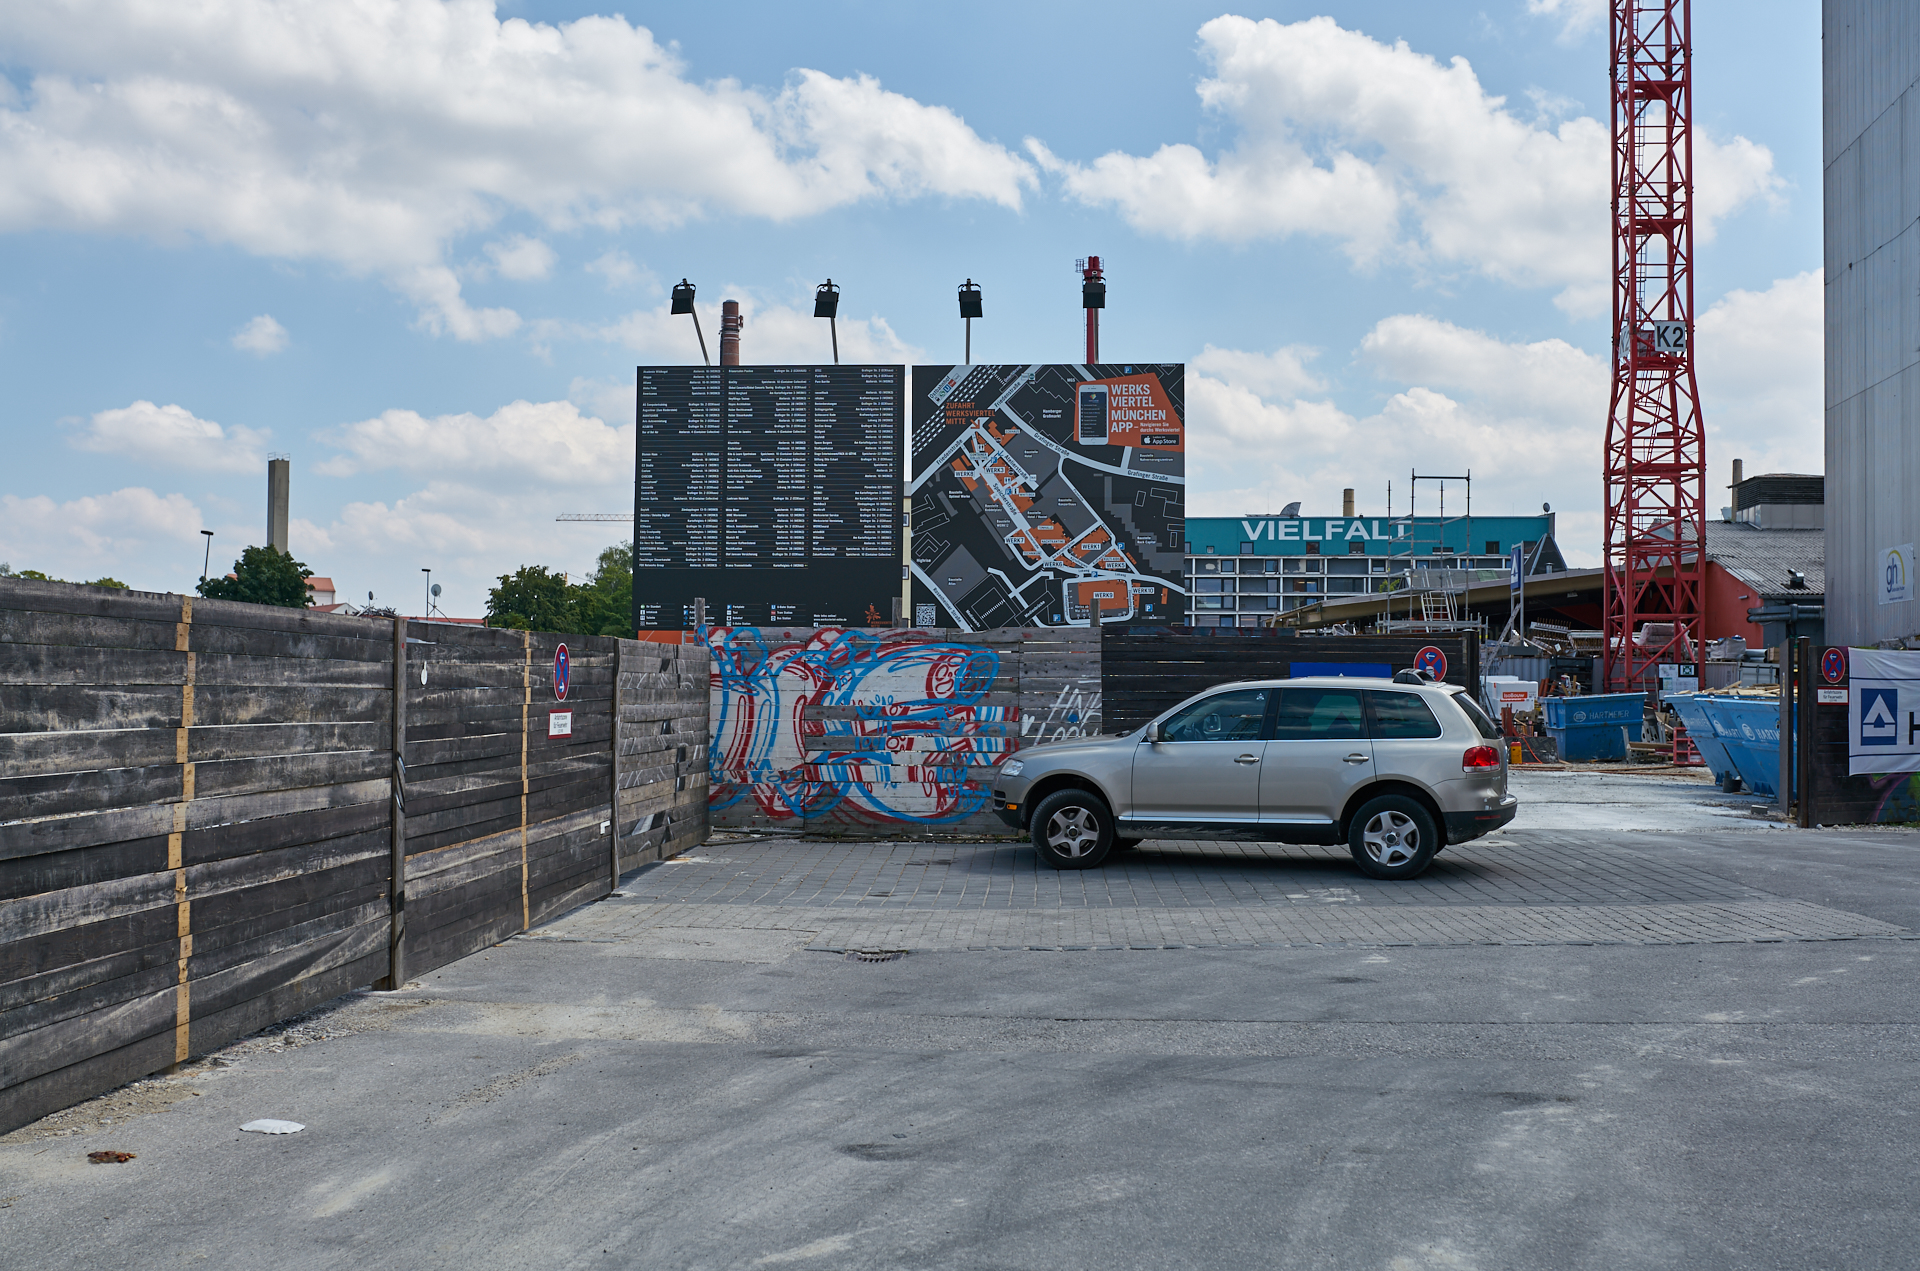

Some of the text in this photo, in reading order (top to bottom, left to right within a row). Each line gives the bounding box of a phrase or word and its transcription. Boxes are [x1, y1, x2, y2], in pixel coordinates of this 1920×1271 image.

[1656, 326, 1684, 348] K2
[929, 375, 950, 399] Ostbahnhof
[994, 381, 1021, 408] Friedenstraße
[1111, 384, 1150, 395] WERKS
[1111, 396, 1154, 407] VIERTEL
[1111, 408, 1166, 420] MÜNCHEN
[1111, 422, 1133, 432] APP
[936, 439, 962, 465] Friedenstraße
[1034, 432, 1070, 456] Grafinger Straße
[1005, 455, 1029, 480] Atelierstraße
[1128, 470, 1150, 479] Grafinger
[1242, 520, 1412, 541] VIELFALT
[1887, 558, 1898, 593] gh
[1590, 710, 1629, 719] HARTMEIER
